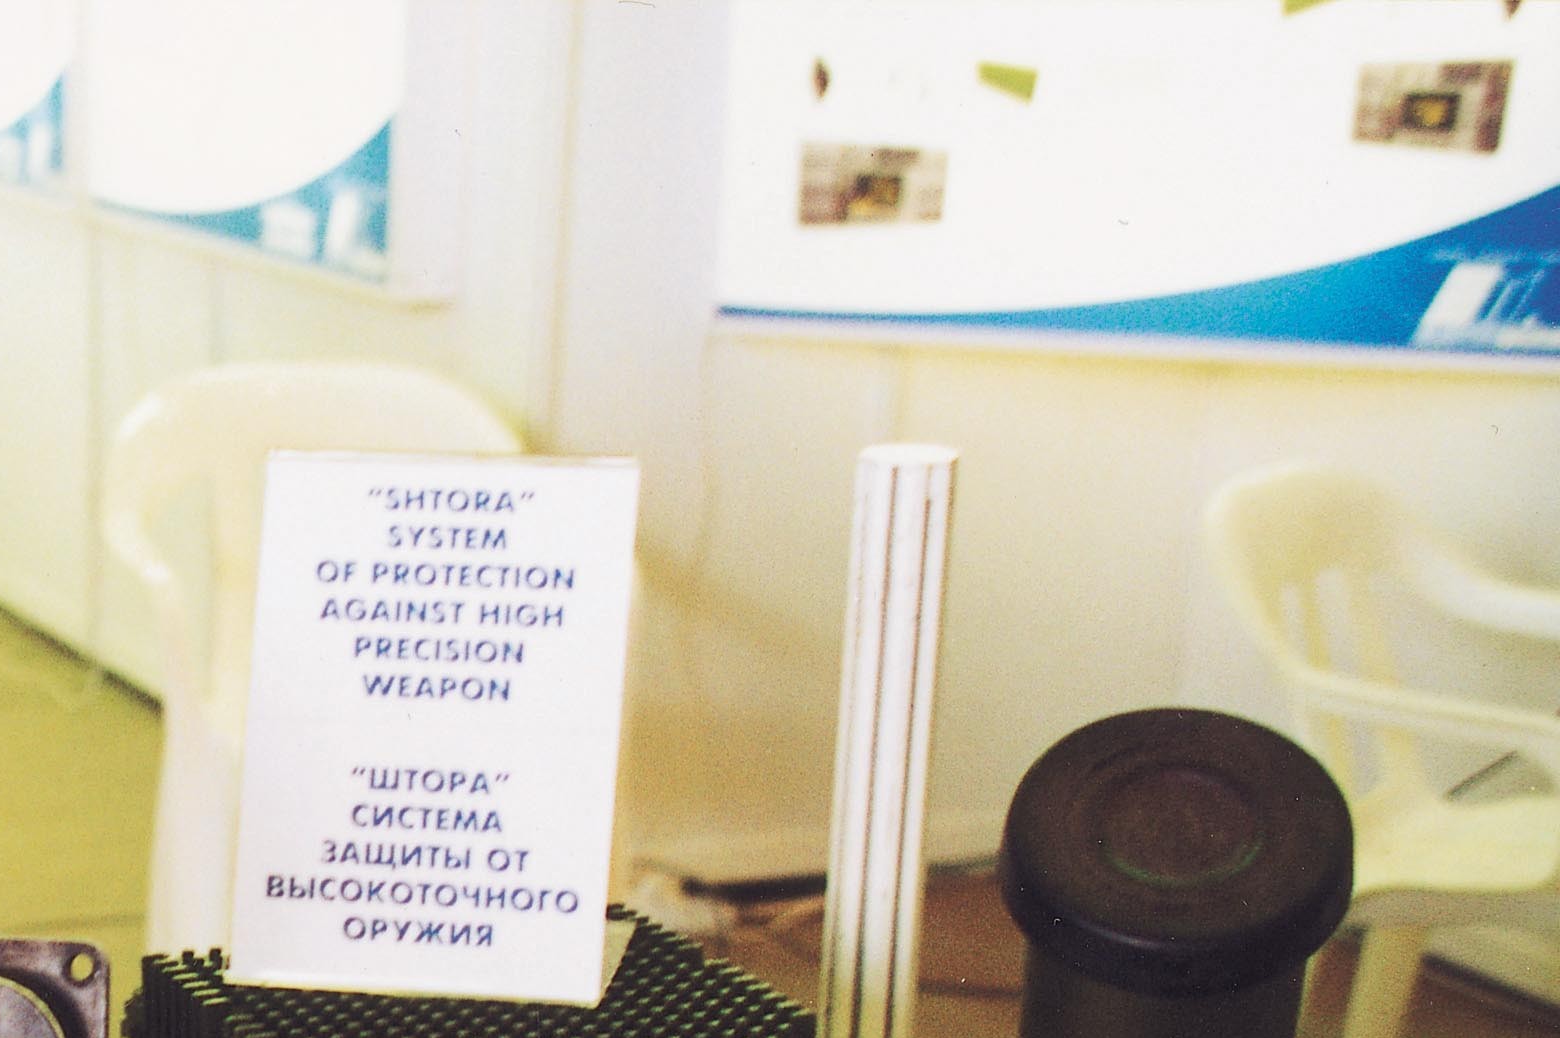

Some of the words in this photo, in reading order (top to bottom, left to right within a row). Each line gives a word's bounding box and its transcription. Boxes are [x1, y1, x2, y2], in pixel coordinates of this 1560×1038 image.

[388, 525, 507, 550] SYSTEM
[315, 560, 359, 584] OF
[371, 562, 575, 590] PROTECTION
[319, 598, 466, 625] AGAINST
[478, 604, 566, 628] HIGH
[353, 635, 525, 664] PRECISION
[363, 674, 511, 702] WEAPON
[350, 804, 503, 833] СИСТЕМА
[321, 839, 472, 871] ЗАЩИТЫ
[486, 847, 531, 873] ОТ
[265, 873, 580, 915] ВЫСОКОТОЧНОГО
[342, 915, 494, 948] ОРУЖИЯ
